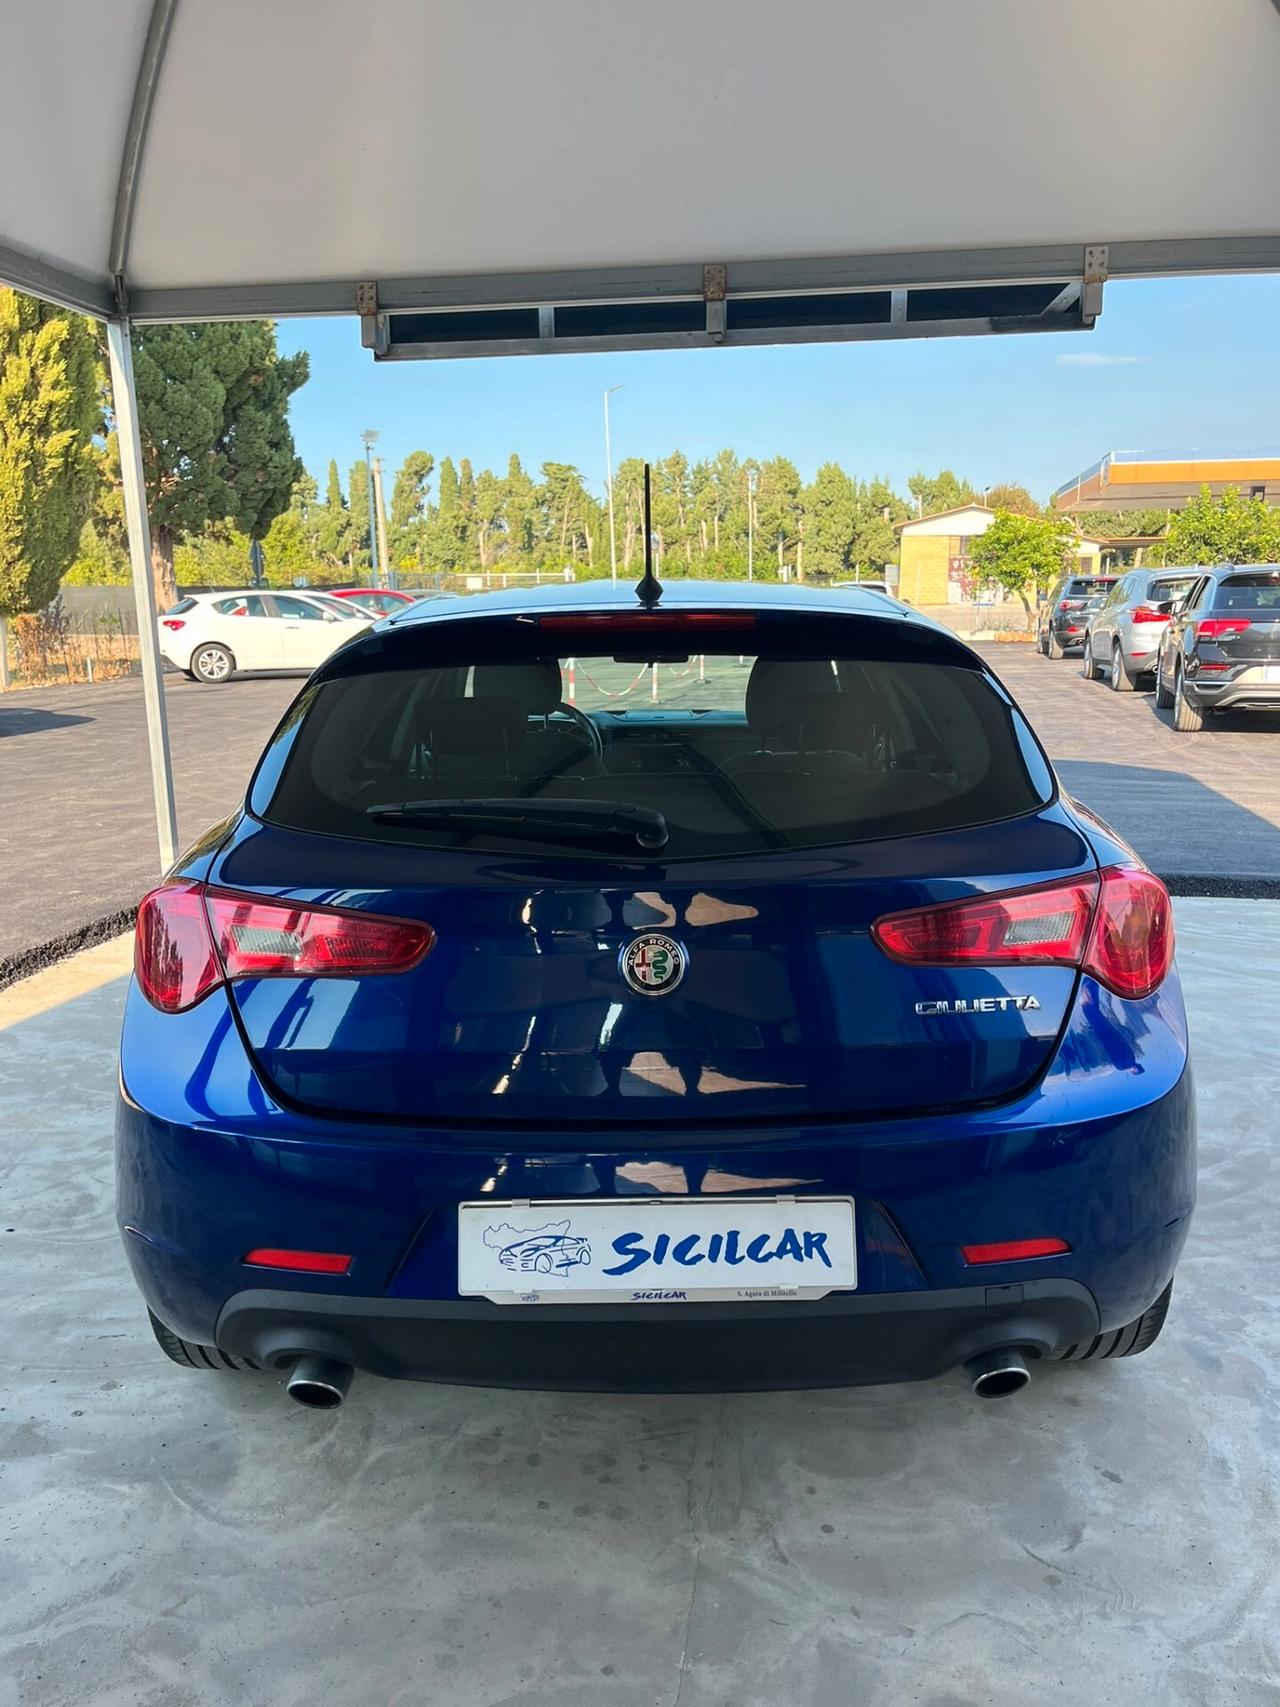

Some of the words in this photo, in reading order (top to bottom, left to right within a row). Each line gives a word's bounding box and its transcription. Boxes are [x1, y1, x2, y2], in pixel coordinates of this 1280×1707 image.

[627, 943, 646, 966] ALFA
[649, 938, 680, 965] ROMEO
[915, 995, 1041, 1015] GIULIETTA
[602, 1228, 832, 1276] SICILCAR
[631, 1291, 687, 1301] SICILCAR
